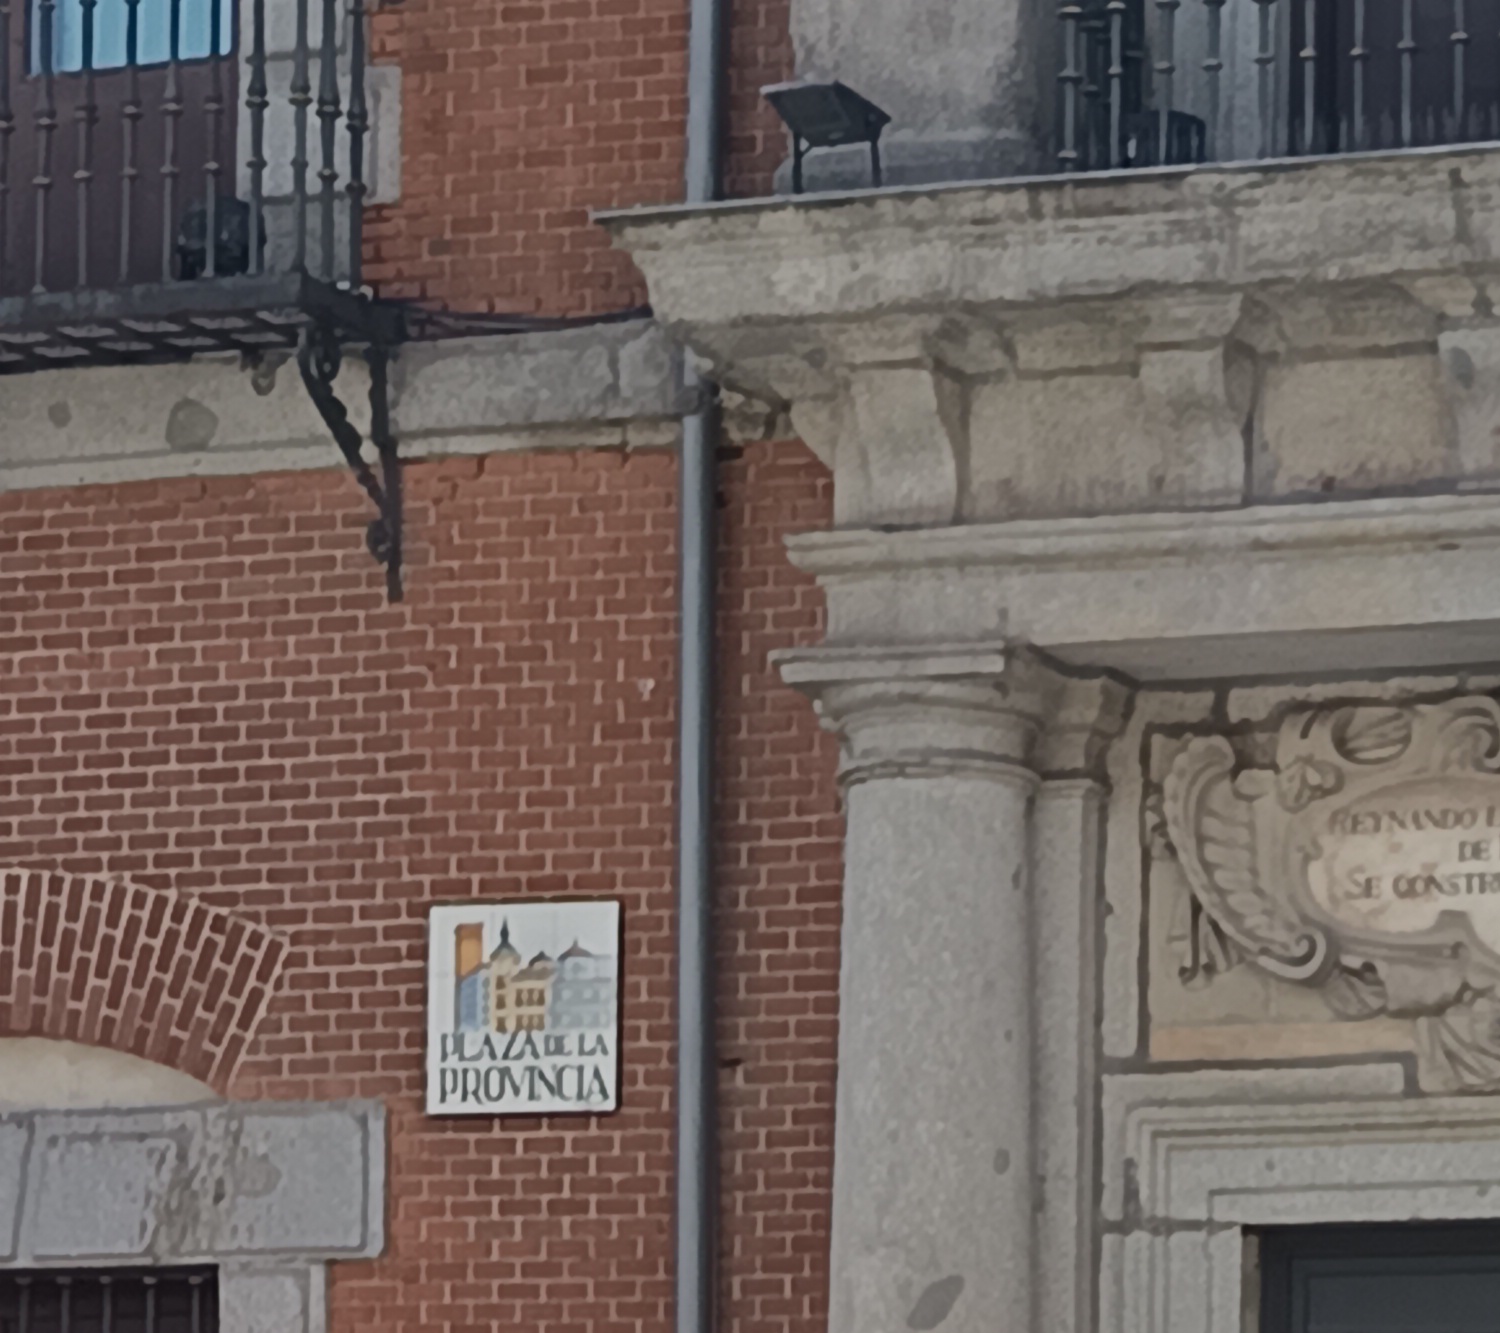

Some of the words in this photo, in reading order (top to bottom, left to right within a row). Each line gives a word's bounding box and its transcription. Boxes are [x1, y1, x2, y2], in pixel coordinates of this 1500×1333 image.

[1458, 840, 1491, 862] DE
[1343, 865, 1381, 899] SE
[440, 1032, 541, 1062] PLAZA
[543, 1033, 573, 1056] DE
[578, 1033, 609, 1056] LA
[439, 1063, 610, 1104] PROVINCIA
